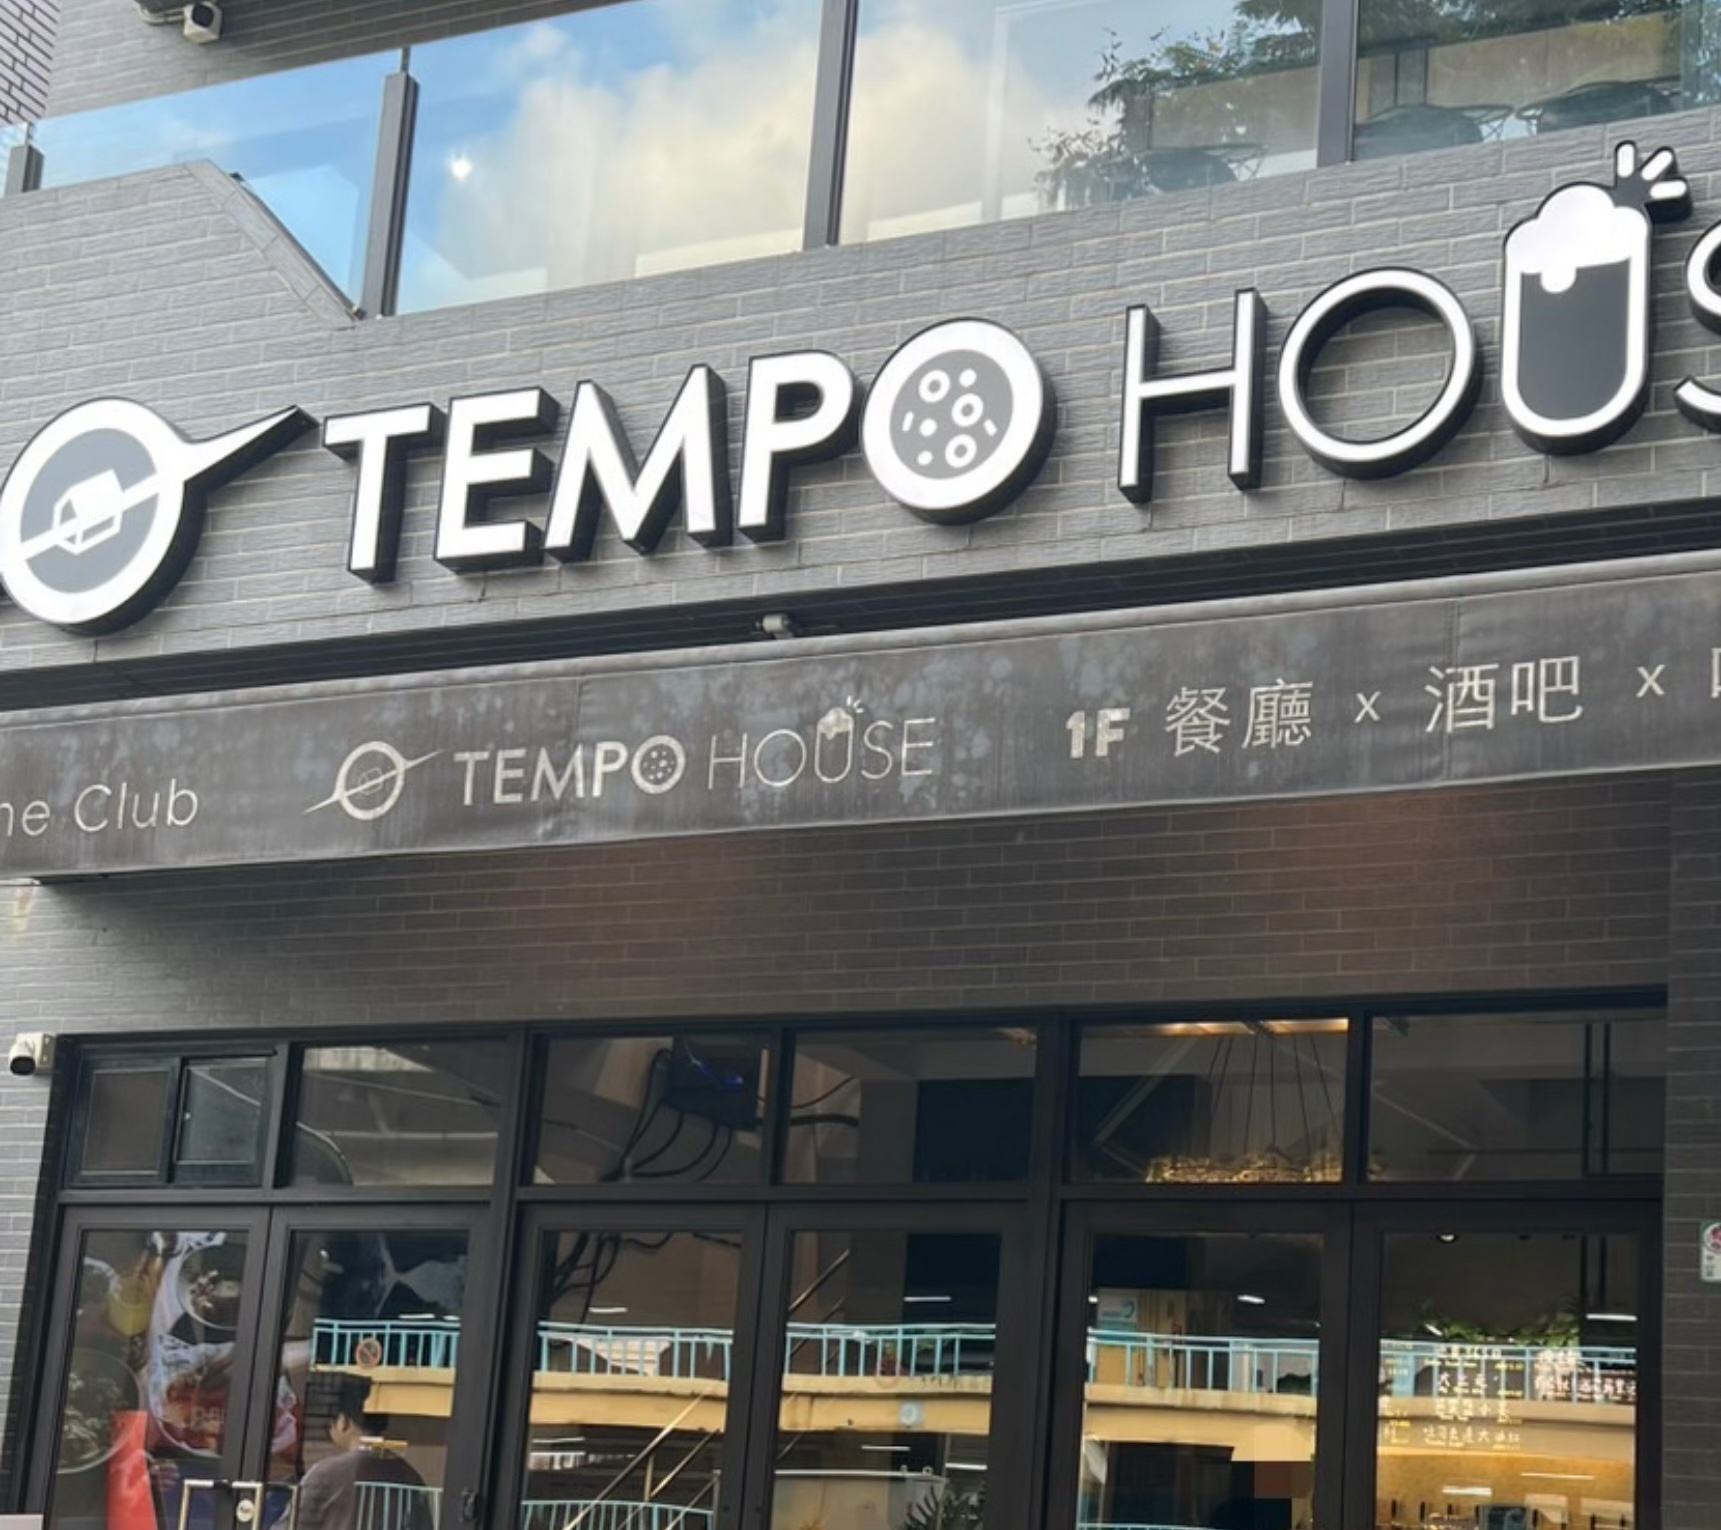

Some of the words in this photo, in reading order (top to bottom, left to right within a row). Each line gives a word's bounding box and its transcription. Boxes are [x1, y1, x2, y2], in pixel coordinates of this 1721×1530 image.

[323, 317, 1054, 578] TEMPO
[455, 734, 686, 807] TEMPO
[708, 704, 937, 794] HOUSE
[1066, 706, 1132, 759] 1F
[1164, 676, 1315, 757] 餐廳
[1423, 655, 1585, 735] 酒吧
[73, 778, 198, 833] Club
